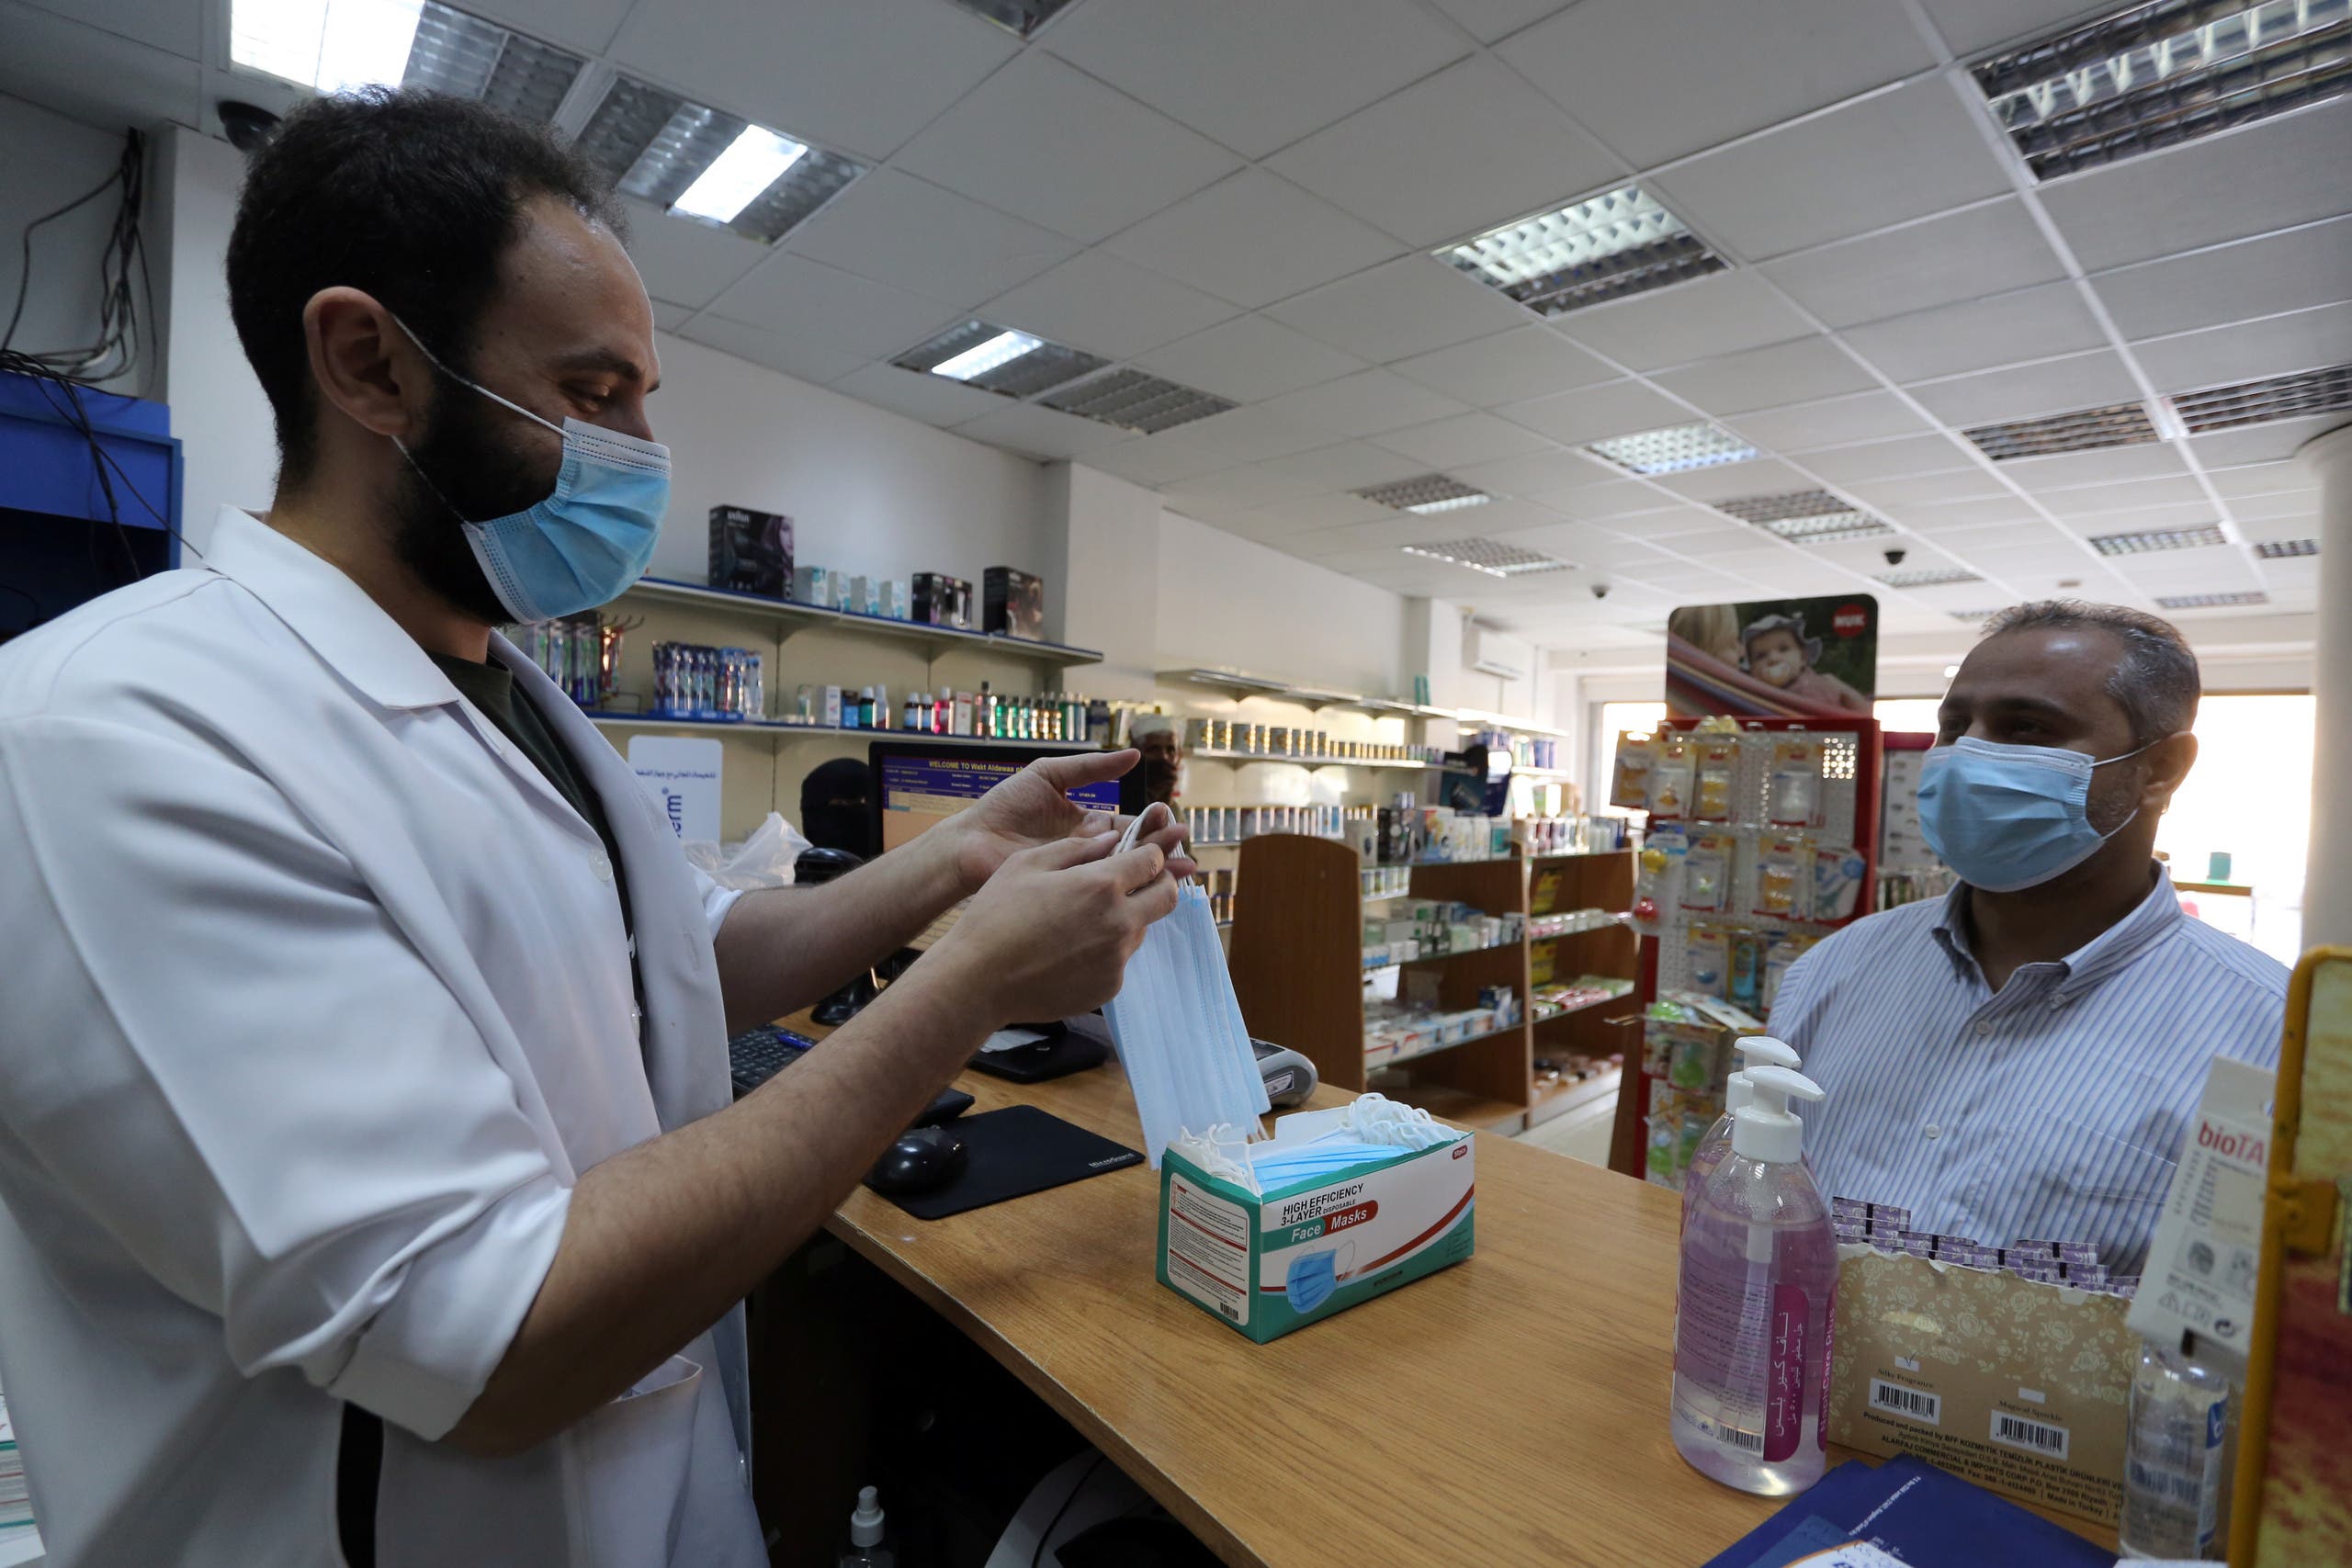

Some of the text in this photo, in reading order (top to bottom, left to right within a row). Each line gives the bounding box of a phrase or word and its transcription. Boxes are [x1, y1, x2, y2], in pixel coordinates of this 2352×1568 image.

[929, 761, 959, 770] WELCOME
[1281, 1199, 1356, 1226] 3-LAYER DISPOSABLE
[1283, 1183, 1363, 1215] HIGH EFFICIENCY
[1291, 1209, 1368, 1242] Face Masks
[1863, 1411, 1894, 1427] Produced
[1896, 1422, 1908, 1430] and
[1909, 1426, 1933, 1438] packed
[1935, 1432, 1942, 1440] by
[1914, 1444, 1962, 1463] COMMERCIAL
[1971, 1461, 2004, 1475] IMPORTS
